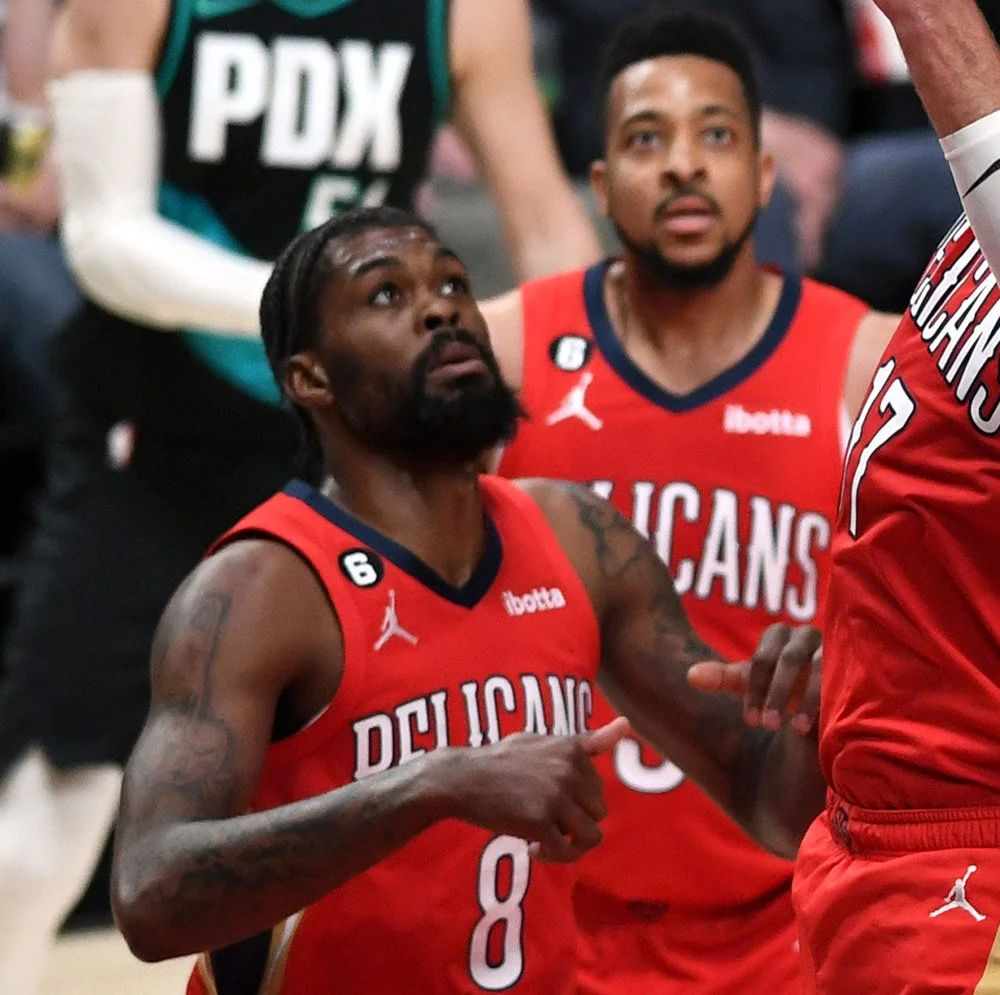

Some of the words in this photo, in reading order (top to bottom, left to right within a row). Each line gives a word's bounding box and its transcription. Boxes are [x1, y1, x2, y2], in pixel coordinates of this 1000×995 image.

[187, 30, 414, 172] PDX
[556, 336, 588, 371] 6
[723, 404, 812, 437] ibotta
[837, 356, 917, 540] 17
[343, 551, 378, 586] 6
[502, 586, 567, 617] ibotta
[469, 834, 531, 991] 8
